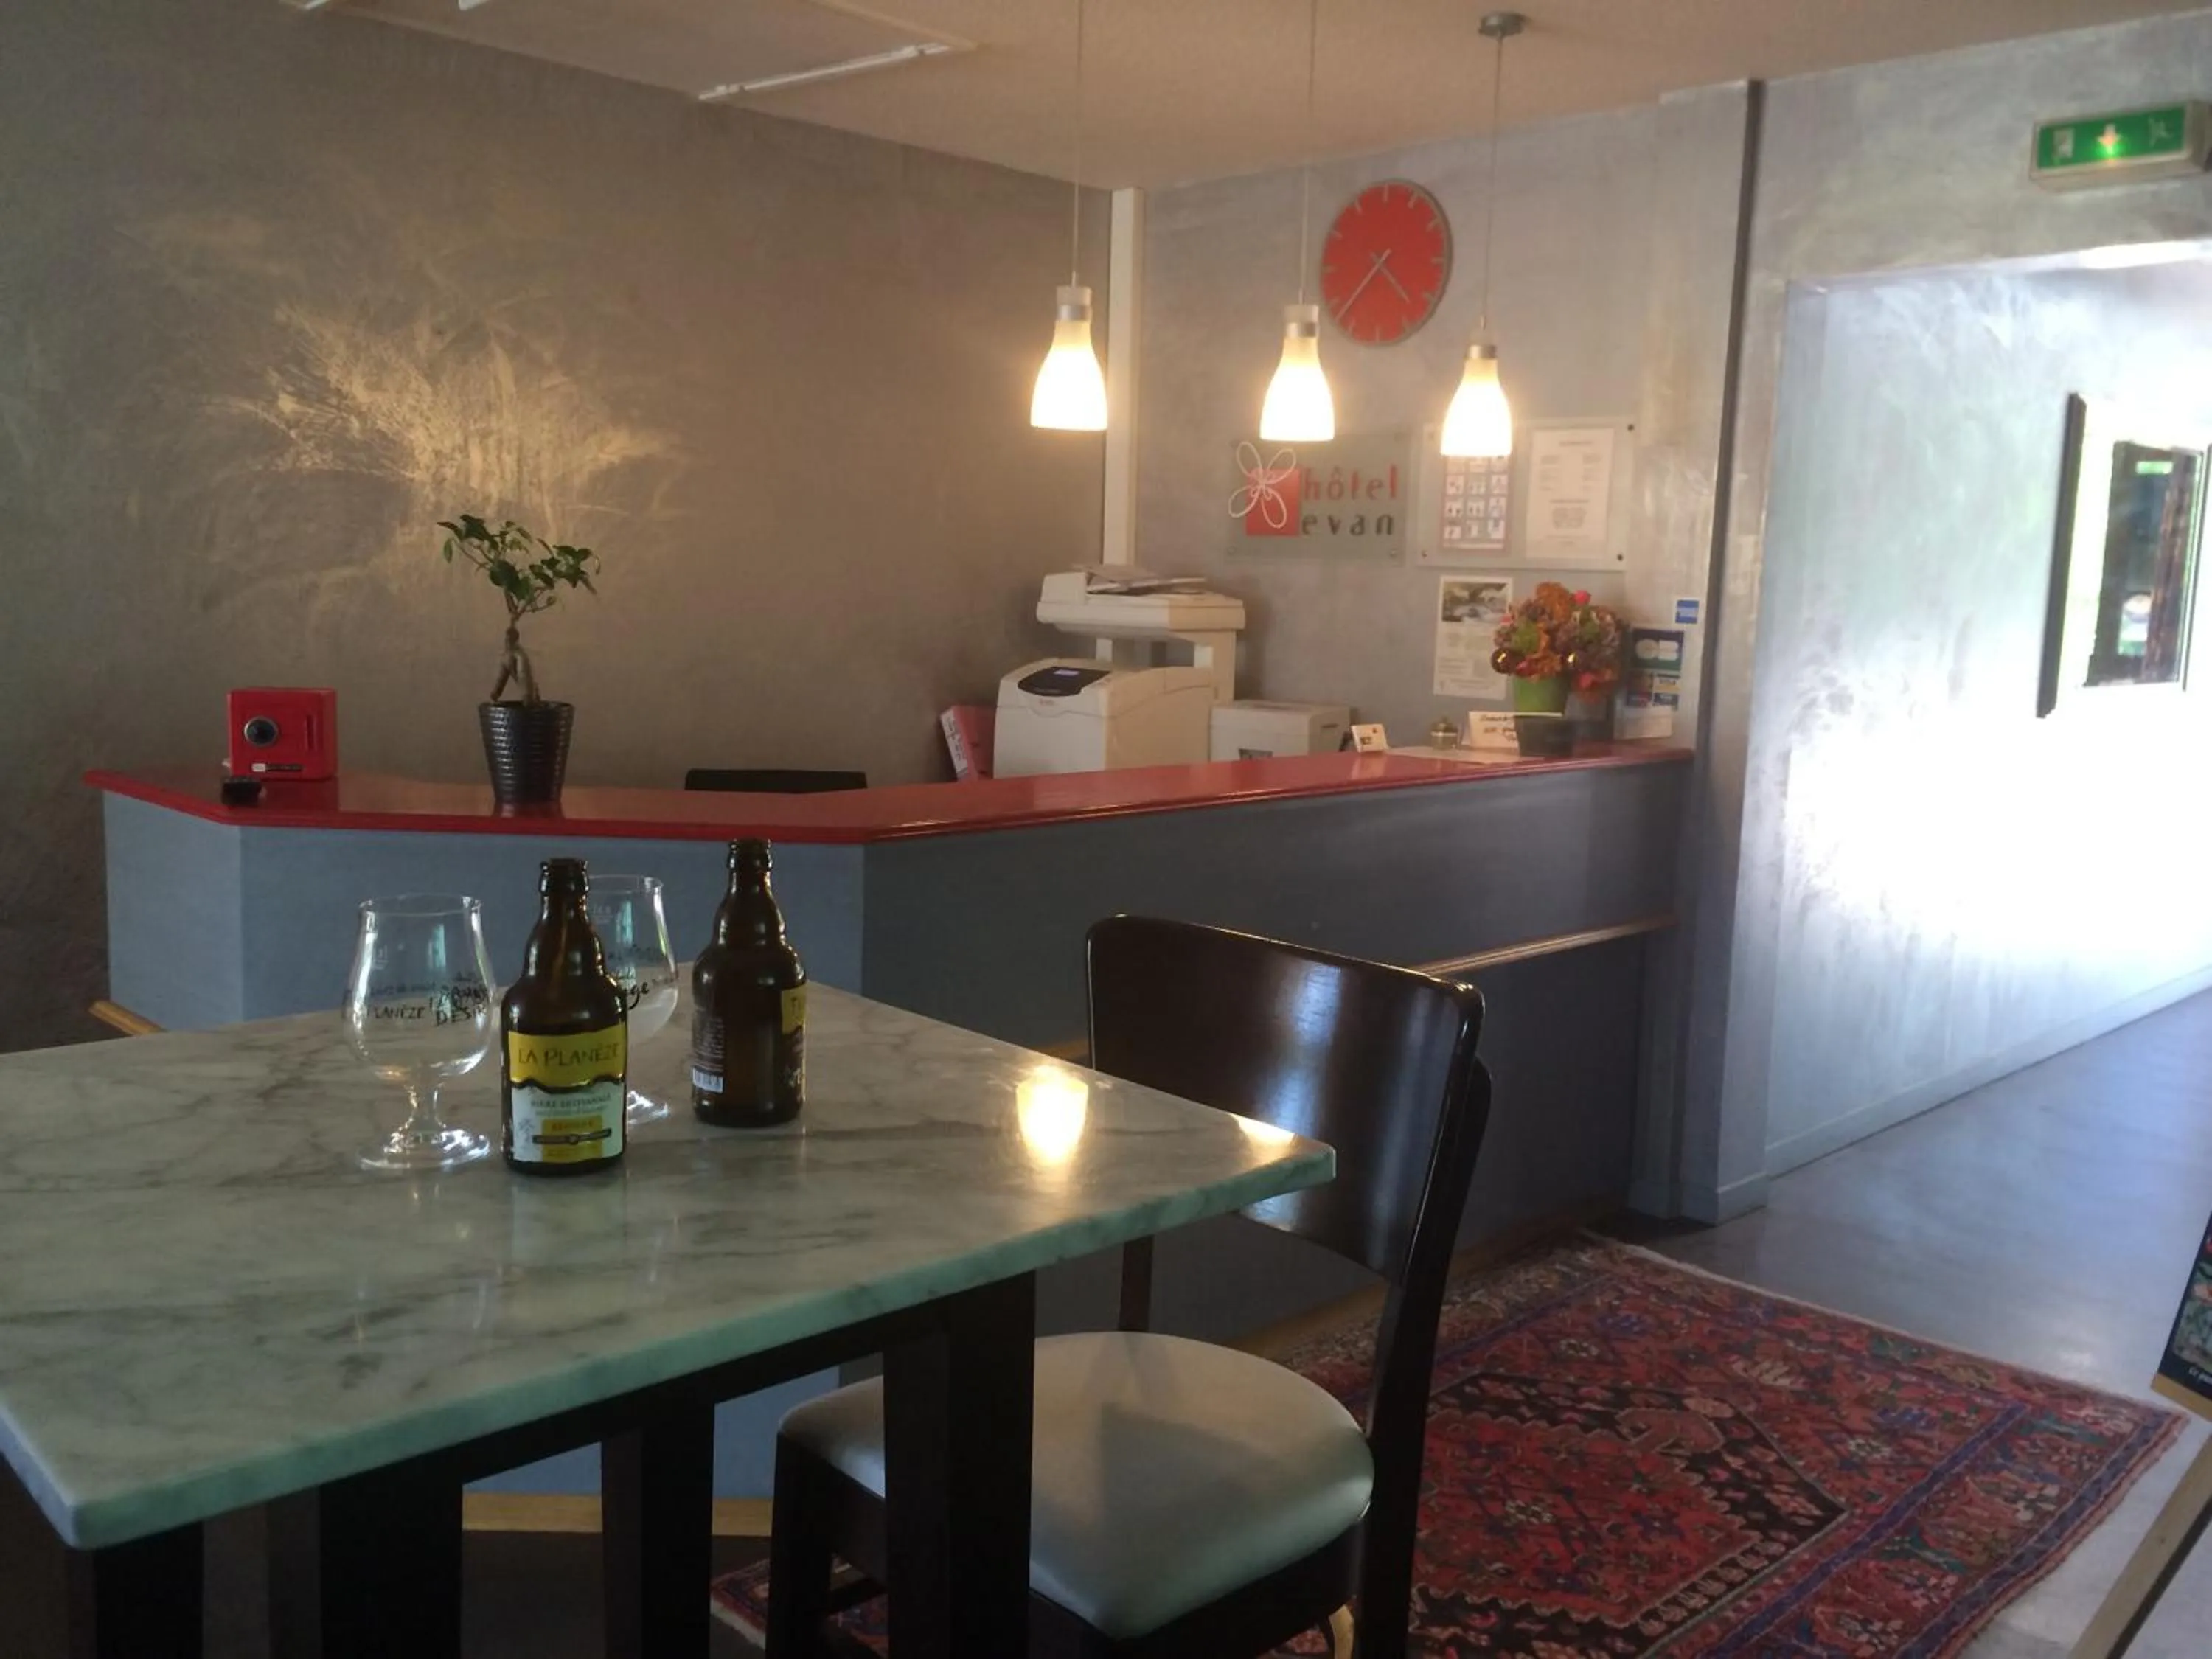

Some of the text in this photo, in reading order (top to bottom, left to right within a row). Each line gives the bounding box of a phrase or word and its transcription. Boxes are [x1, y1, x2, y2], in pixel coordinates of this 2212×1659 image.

[1304, 464, 1397, 501] hôtel
[1301, 514, 1395, 536] evan
[518, 1048, 538, 1064] LA
